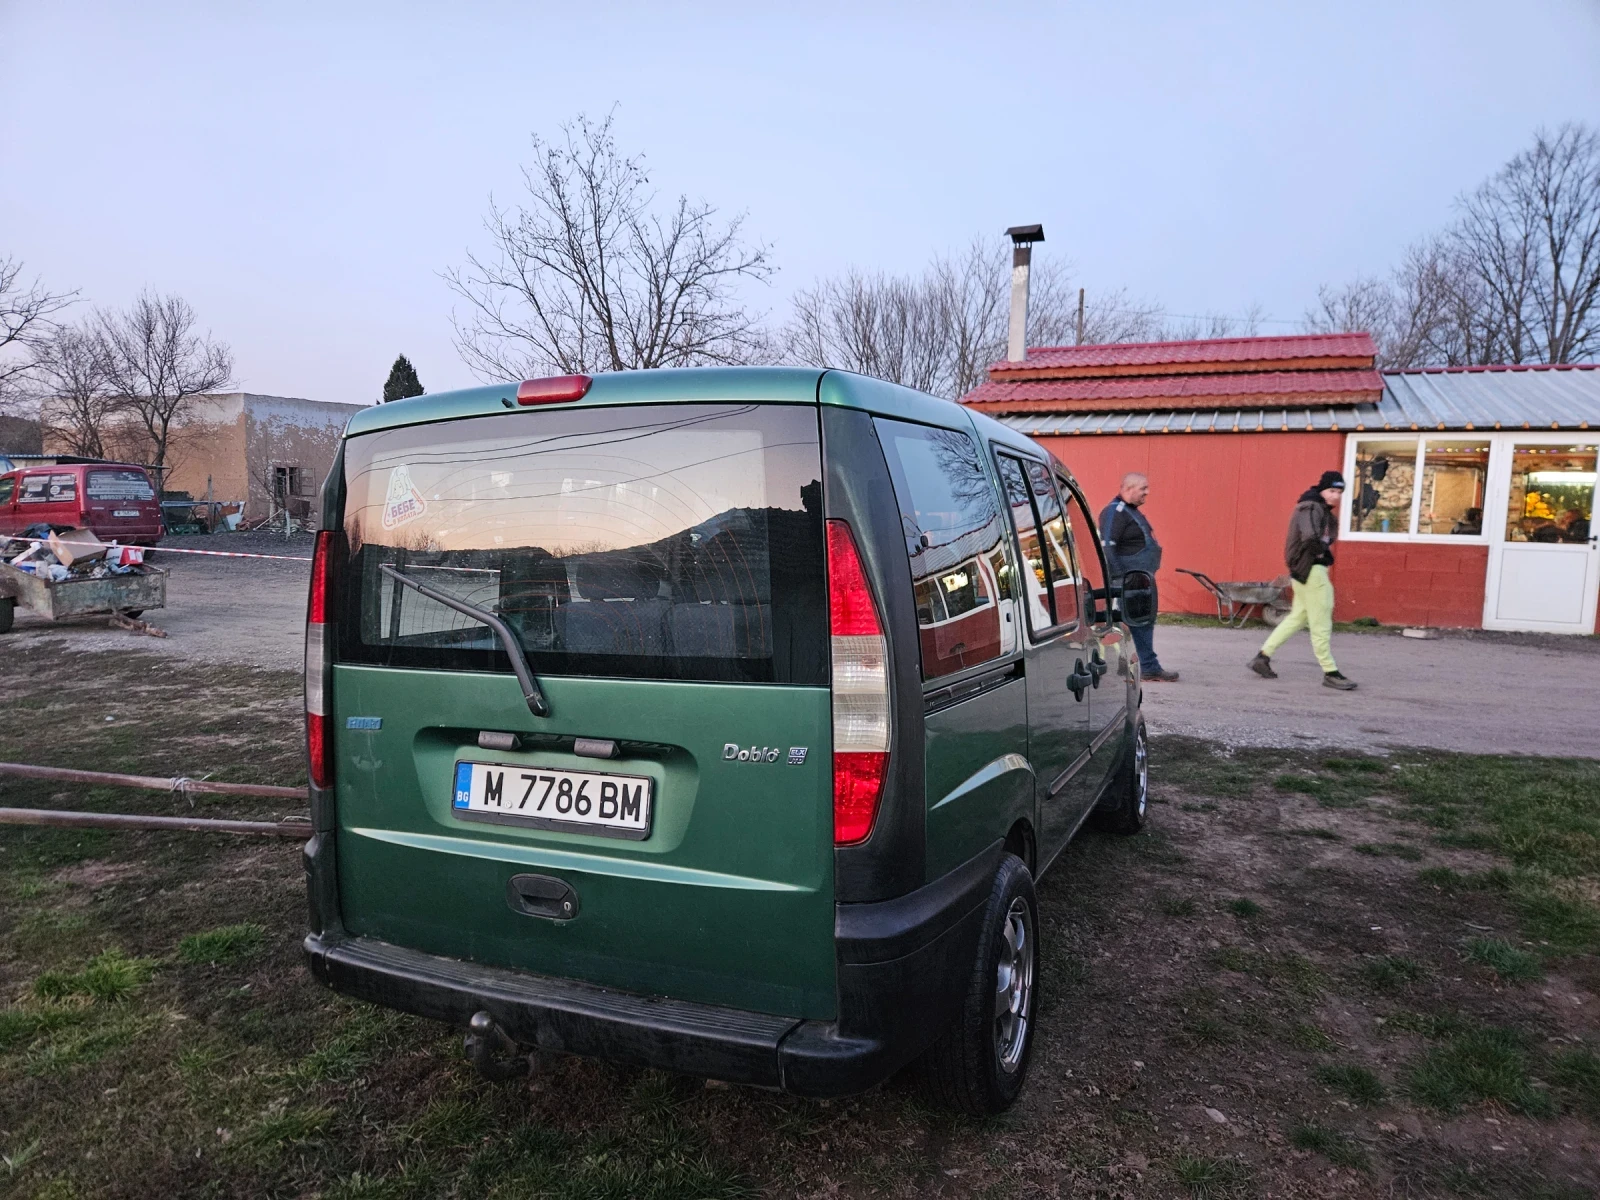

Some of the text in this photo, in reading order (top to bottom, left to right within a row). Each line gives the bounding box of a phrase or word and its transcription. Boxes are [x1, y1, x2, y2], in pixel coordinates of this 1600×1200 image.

[391, 499, 415, 518] БЕБЕ
[457, 790, 469, 802] BG
[484, 771, 642, 822] M 7786 BM
